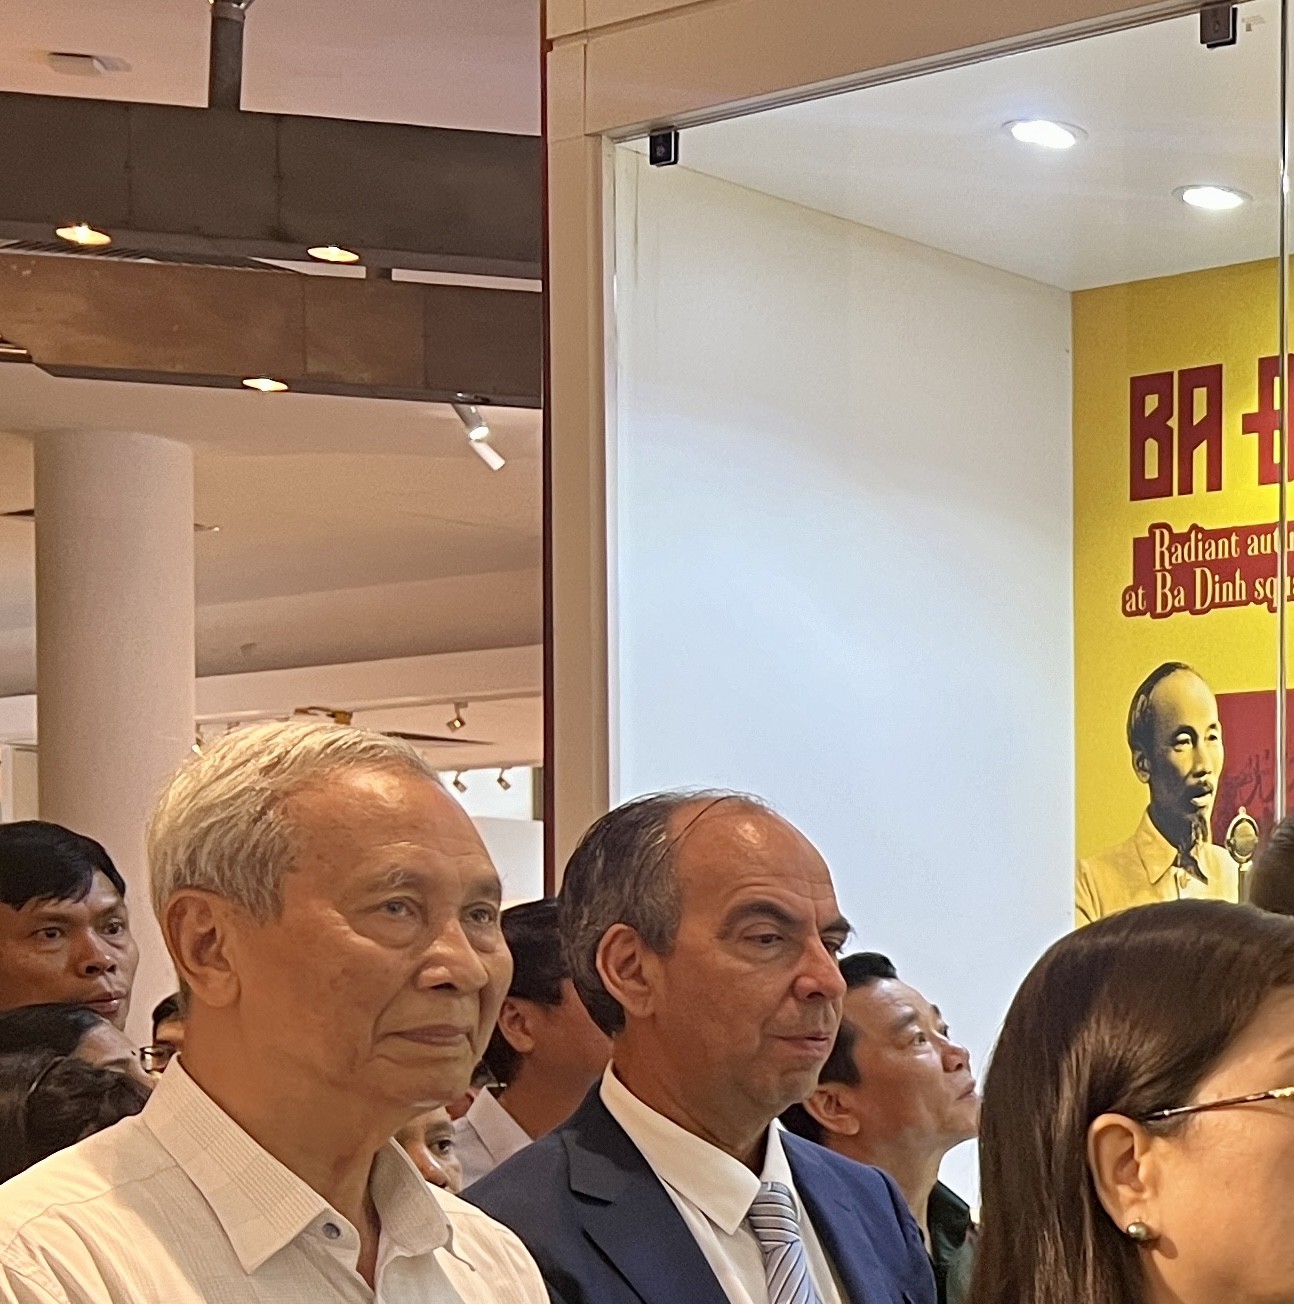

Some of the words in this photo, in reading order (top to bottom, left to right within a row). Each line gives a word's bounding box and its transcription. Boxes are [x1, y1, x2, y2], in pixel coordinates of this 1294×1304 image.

[1129, 362, 1223, 502] BA
[1152, 527, 1241, 571] Radiant
[1124, 584, 1148, 613] at
[1154, 570, 1186, 615] Ba
[1193, 566, 1248, 611] Dinh
